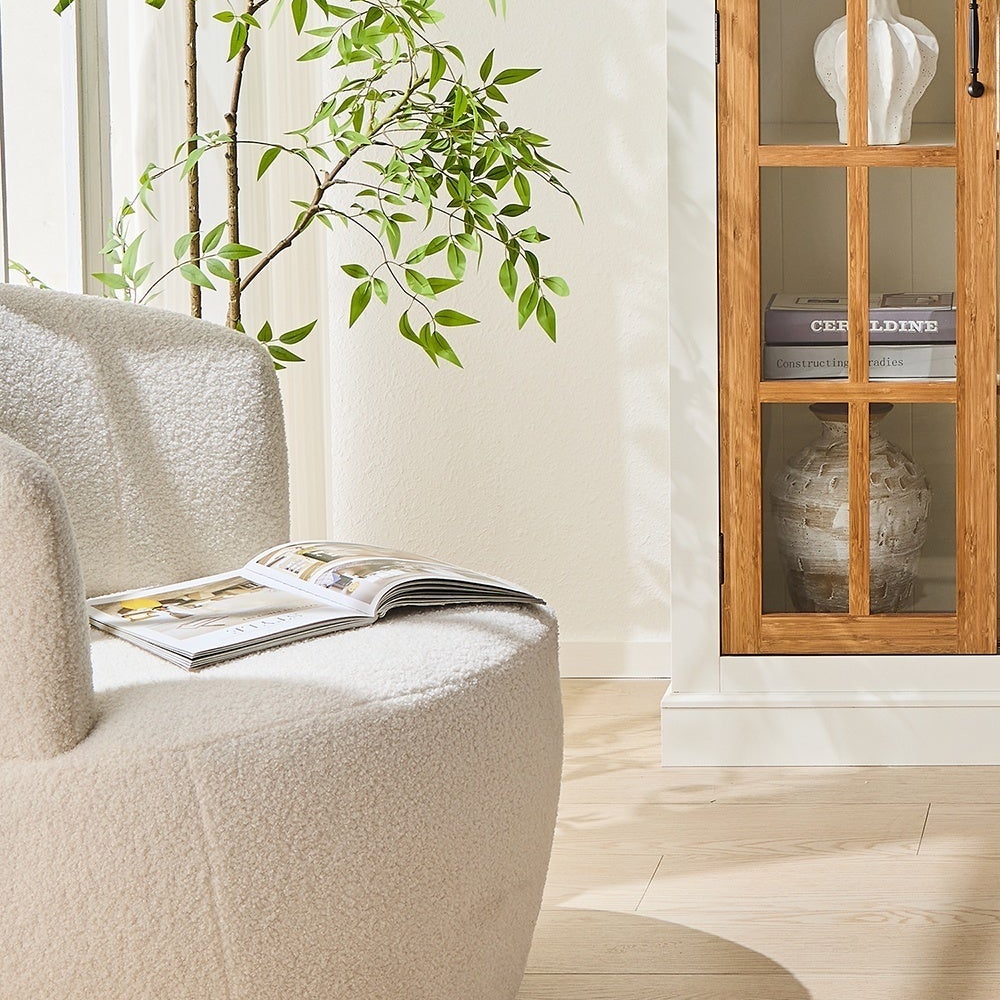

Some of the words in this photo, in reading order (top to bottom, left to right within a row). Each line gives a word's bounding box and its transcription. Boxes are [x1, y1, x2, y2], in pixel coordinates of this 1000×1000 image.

[810, 319, 939, 334] CERLDINE
[776, 358, 849, 369] Constructing
[867, 357, 904, 368] radies
